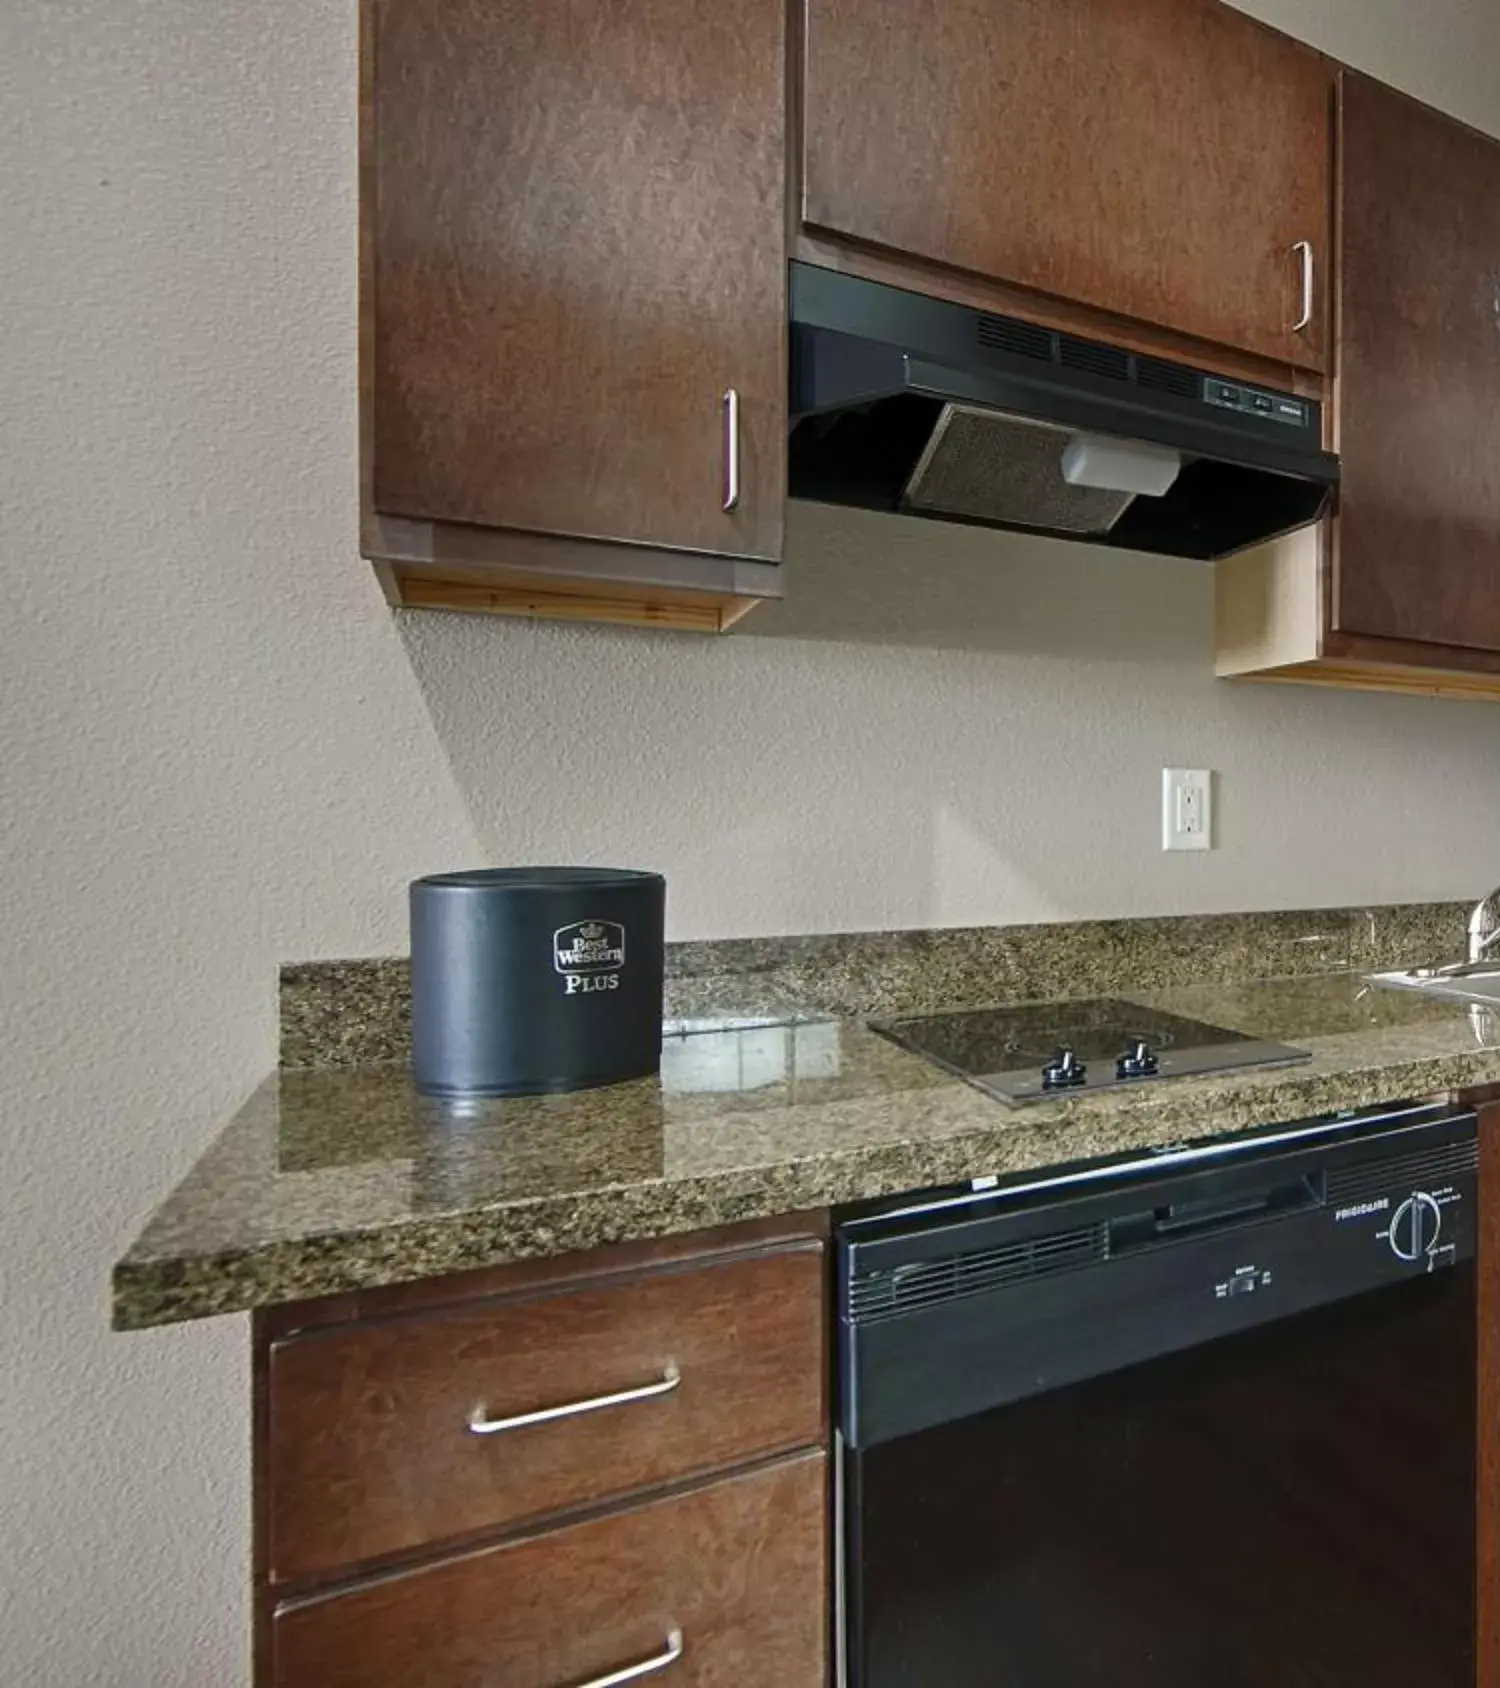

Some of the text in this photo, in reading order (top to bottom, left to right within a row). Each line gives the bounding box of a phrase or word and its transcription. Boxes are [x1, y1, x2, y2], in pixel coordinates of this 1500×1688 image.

[573, 937, 609, 952] Best
[558, 947, 622, 965] Western
[564, 974, 620, 994] PLUS
[1335, 1197, 1390, 1222] FRIGIDAIRE
